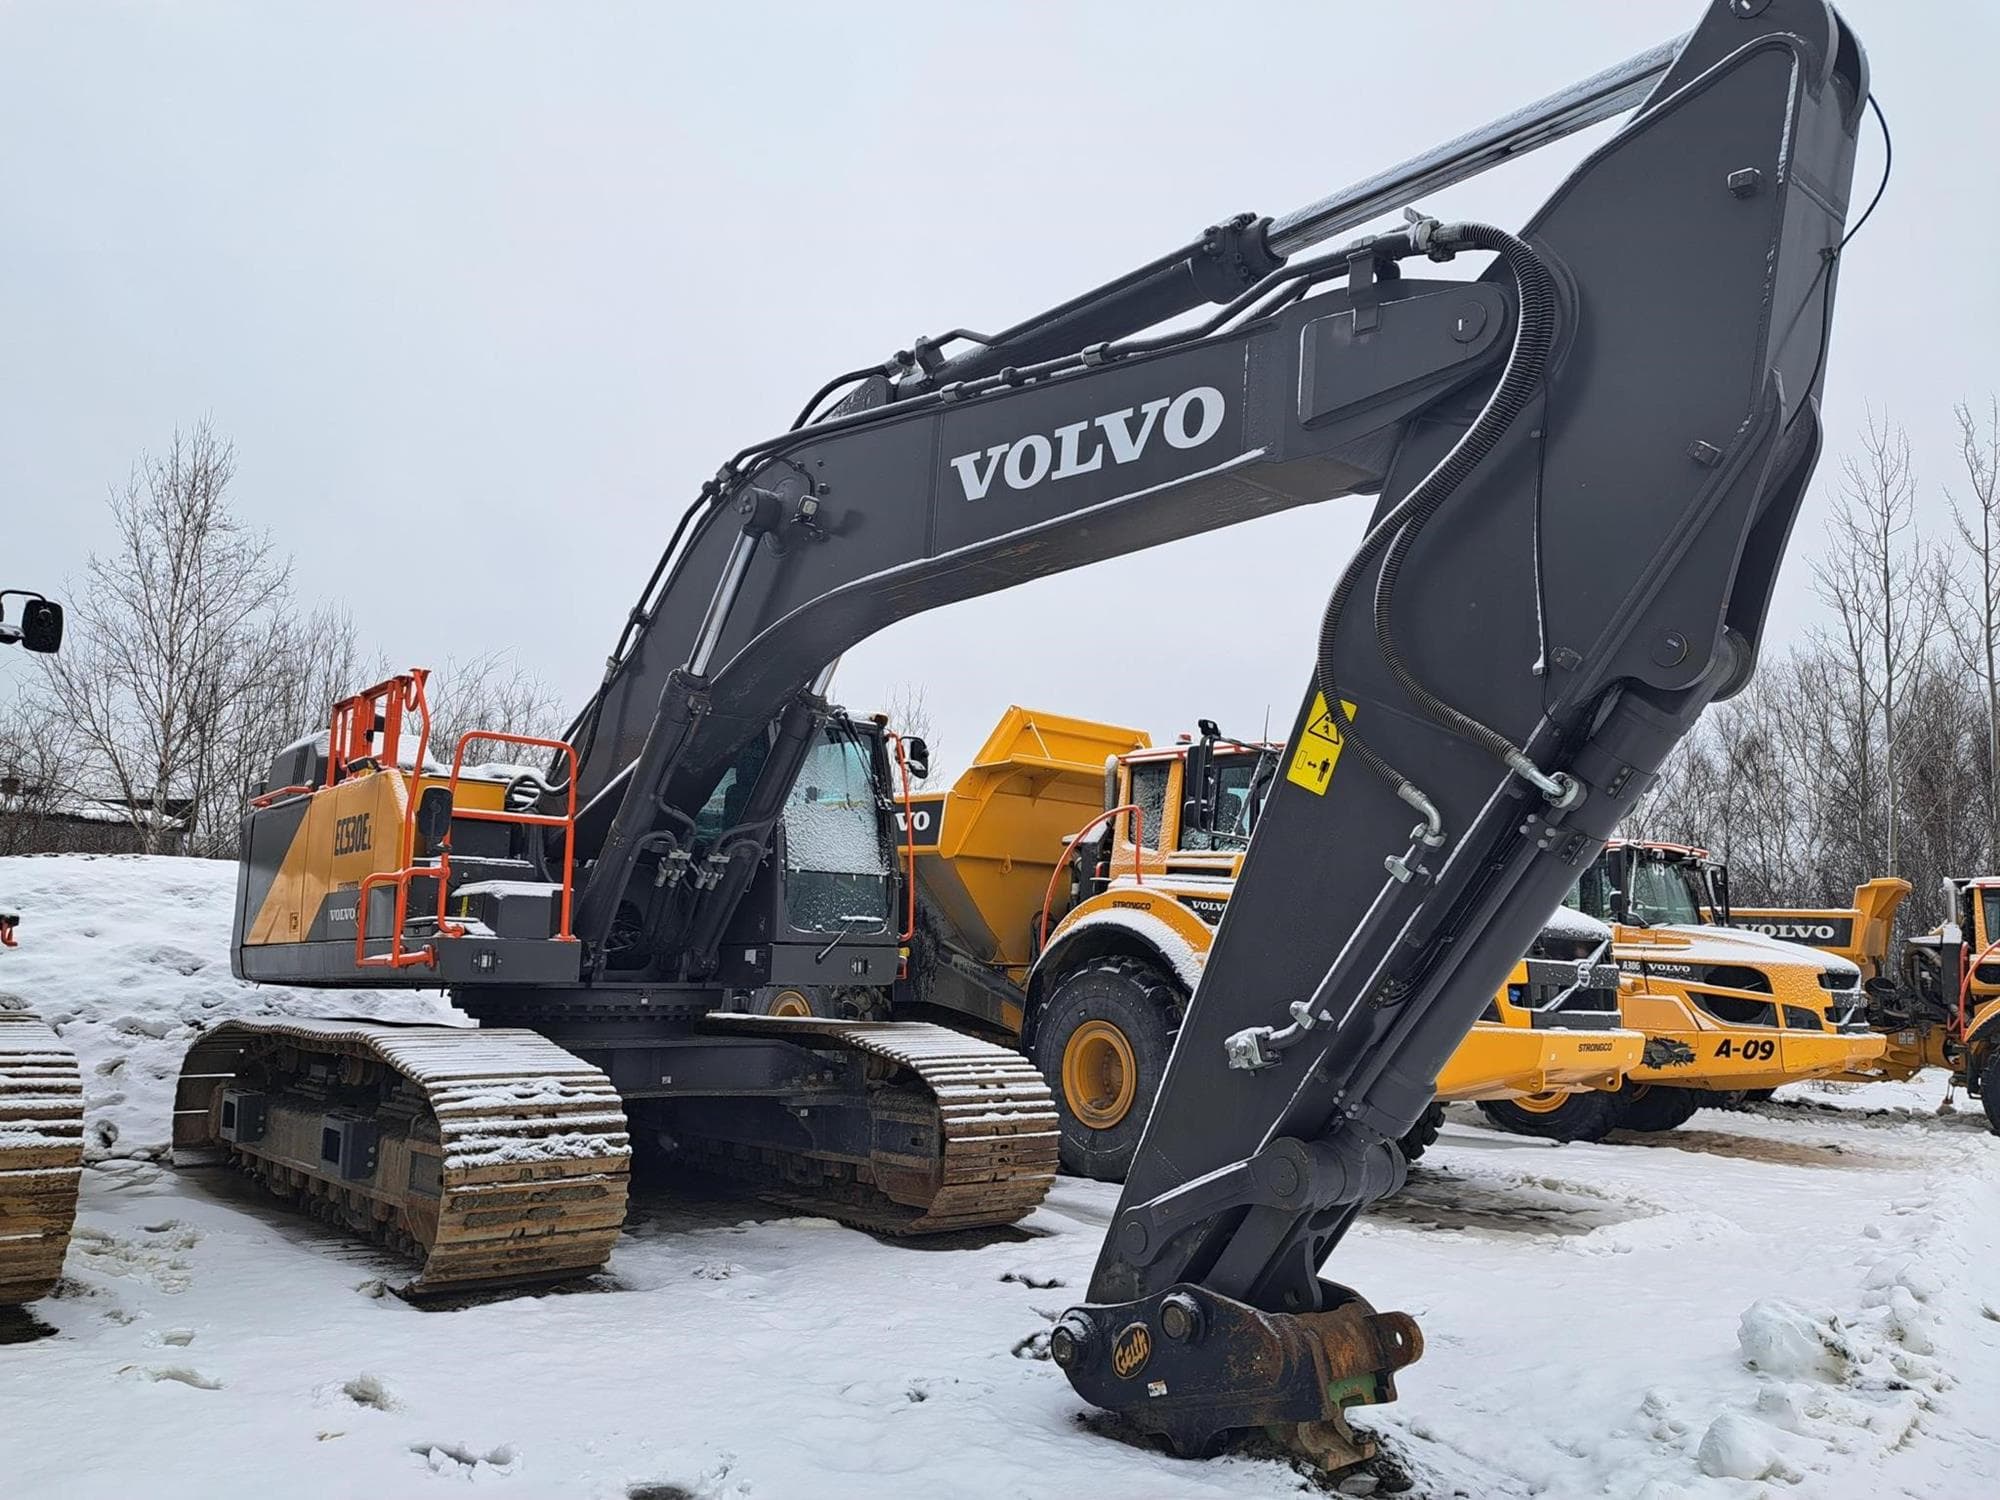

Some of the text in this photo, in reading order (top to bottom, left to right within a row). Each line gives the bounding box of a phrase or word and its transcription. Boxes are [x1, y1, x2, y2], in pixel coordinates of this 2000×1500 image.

[950, 386, 1226, 501] VOLVO
[1111, 900, 1152, 911] STRONGCO
[1191, 900, 1226, 912] VOLV
[329, 907, 356, 922] VOLVO
[1648, 963, 1691, 973] VOLVO
[1577, 1041, 1613, 1053] STRONGCO
[1713, 1038, 1775, 1061] A-09
